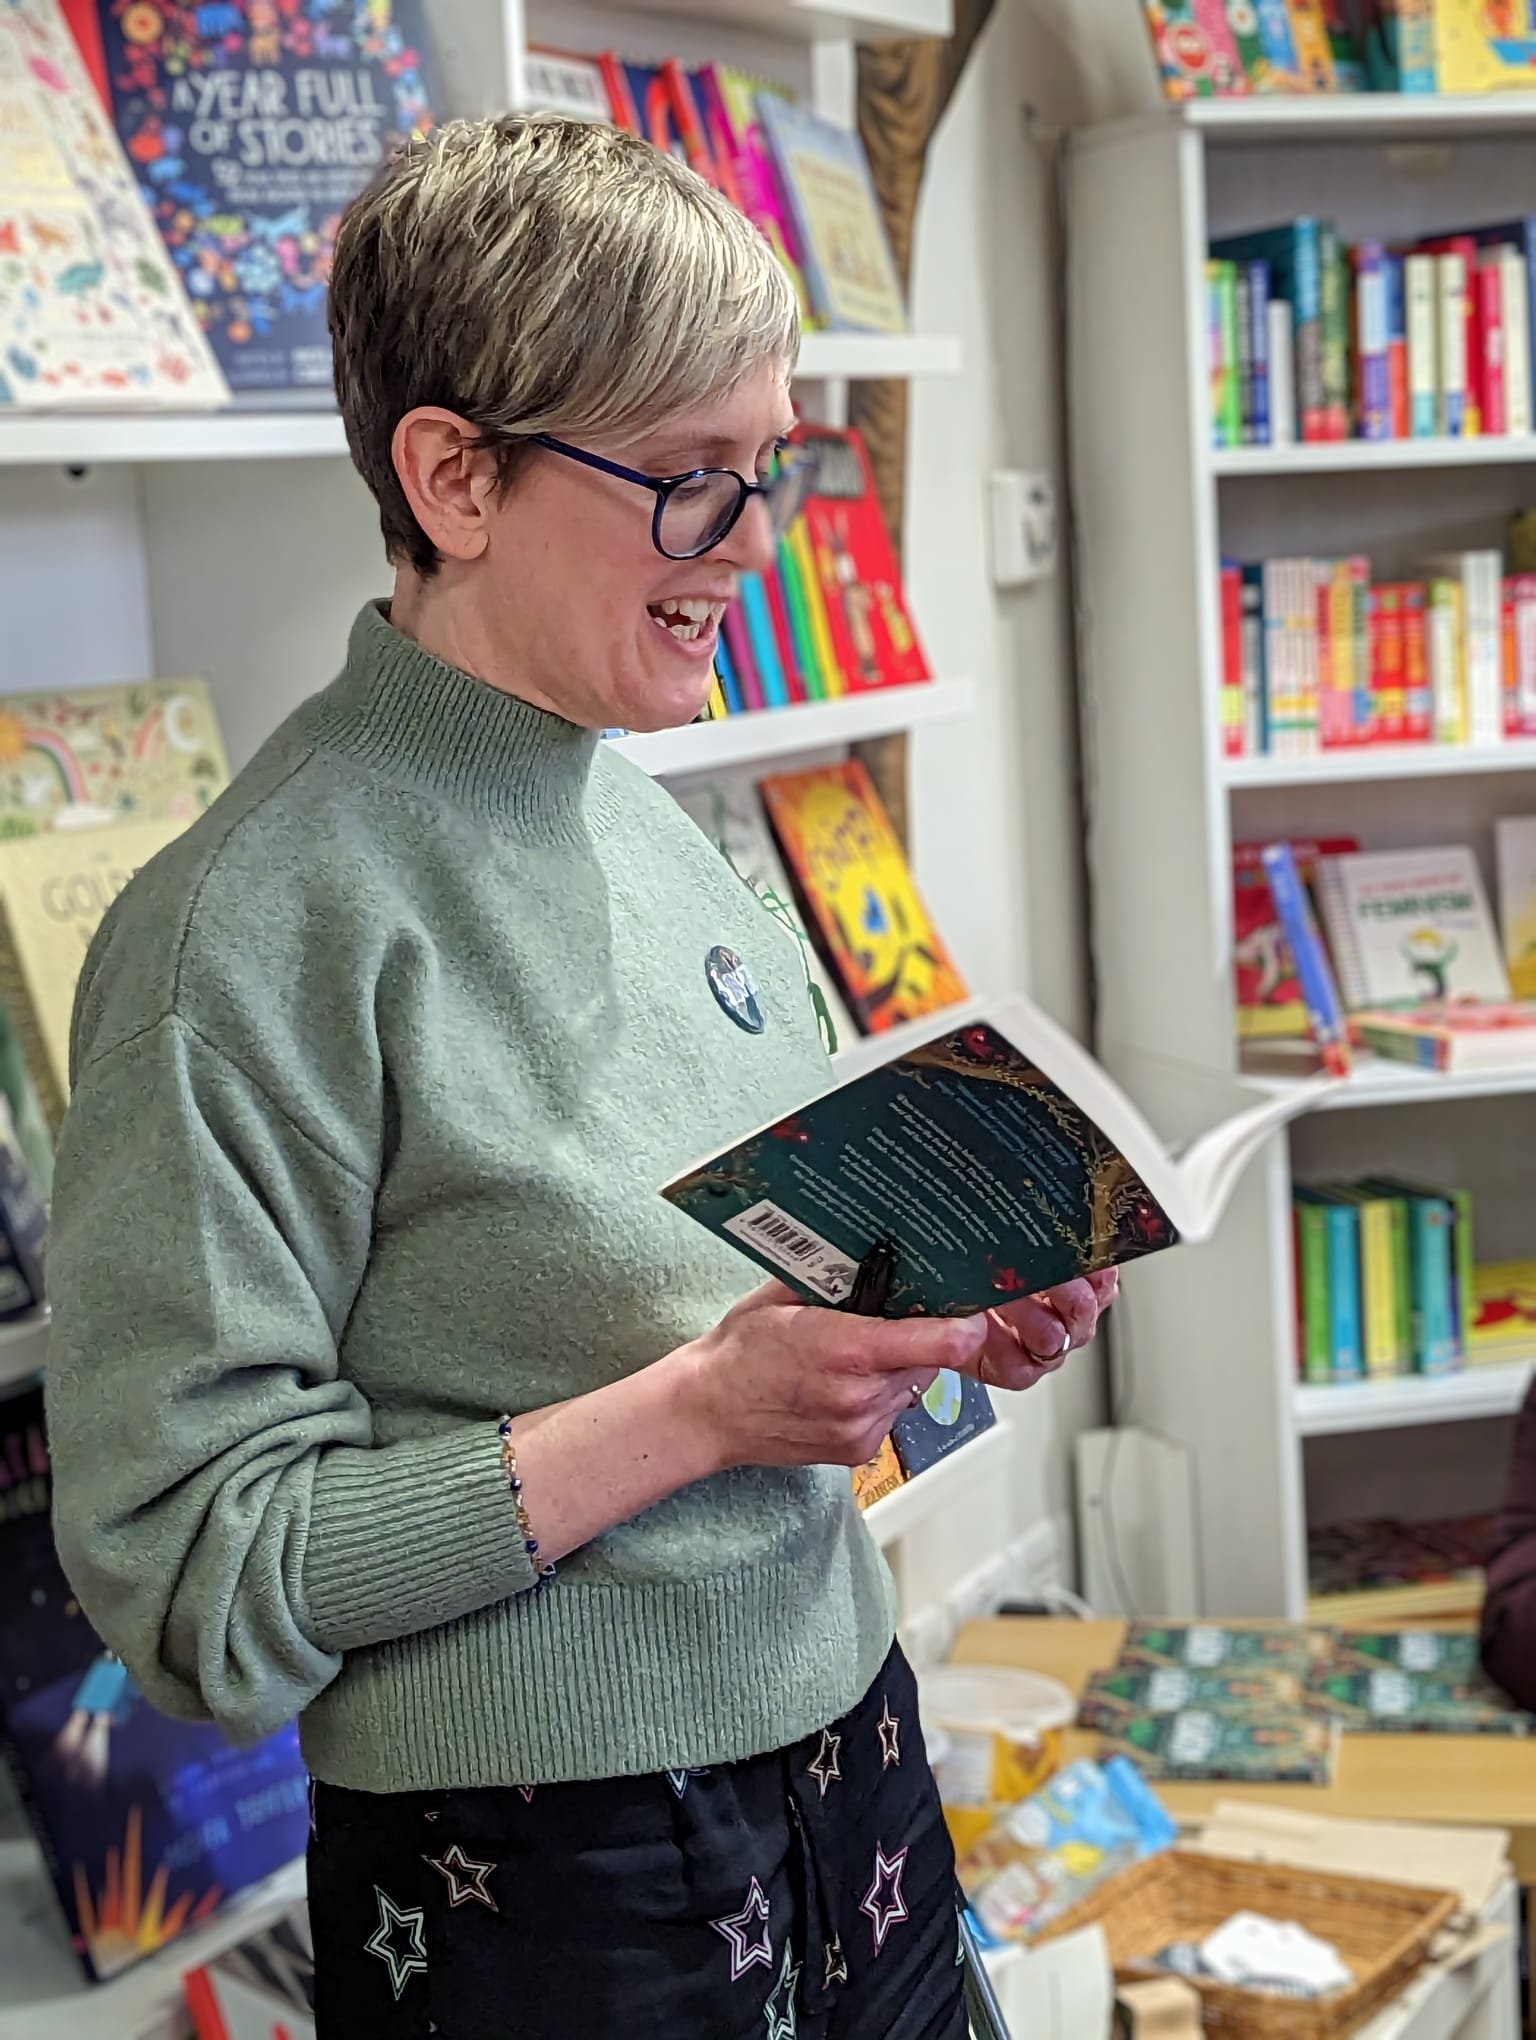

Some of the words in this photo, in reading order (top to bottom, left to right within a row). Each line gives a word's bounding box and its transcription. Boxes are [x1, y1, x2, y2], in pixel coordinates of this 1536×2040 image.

[172, 78, 195, 113] A
[189, 68, 290, 119] YEAR
[295, 68, 387, 118] FULL
[189, 119, 231, 155] OF
[238, 117, 383, 167] STORIES
